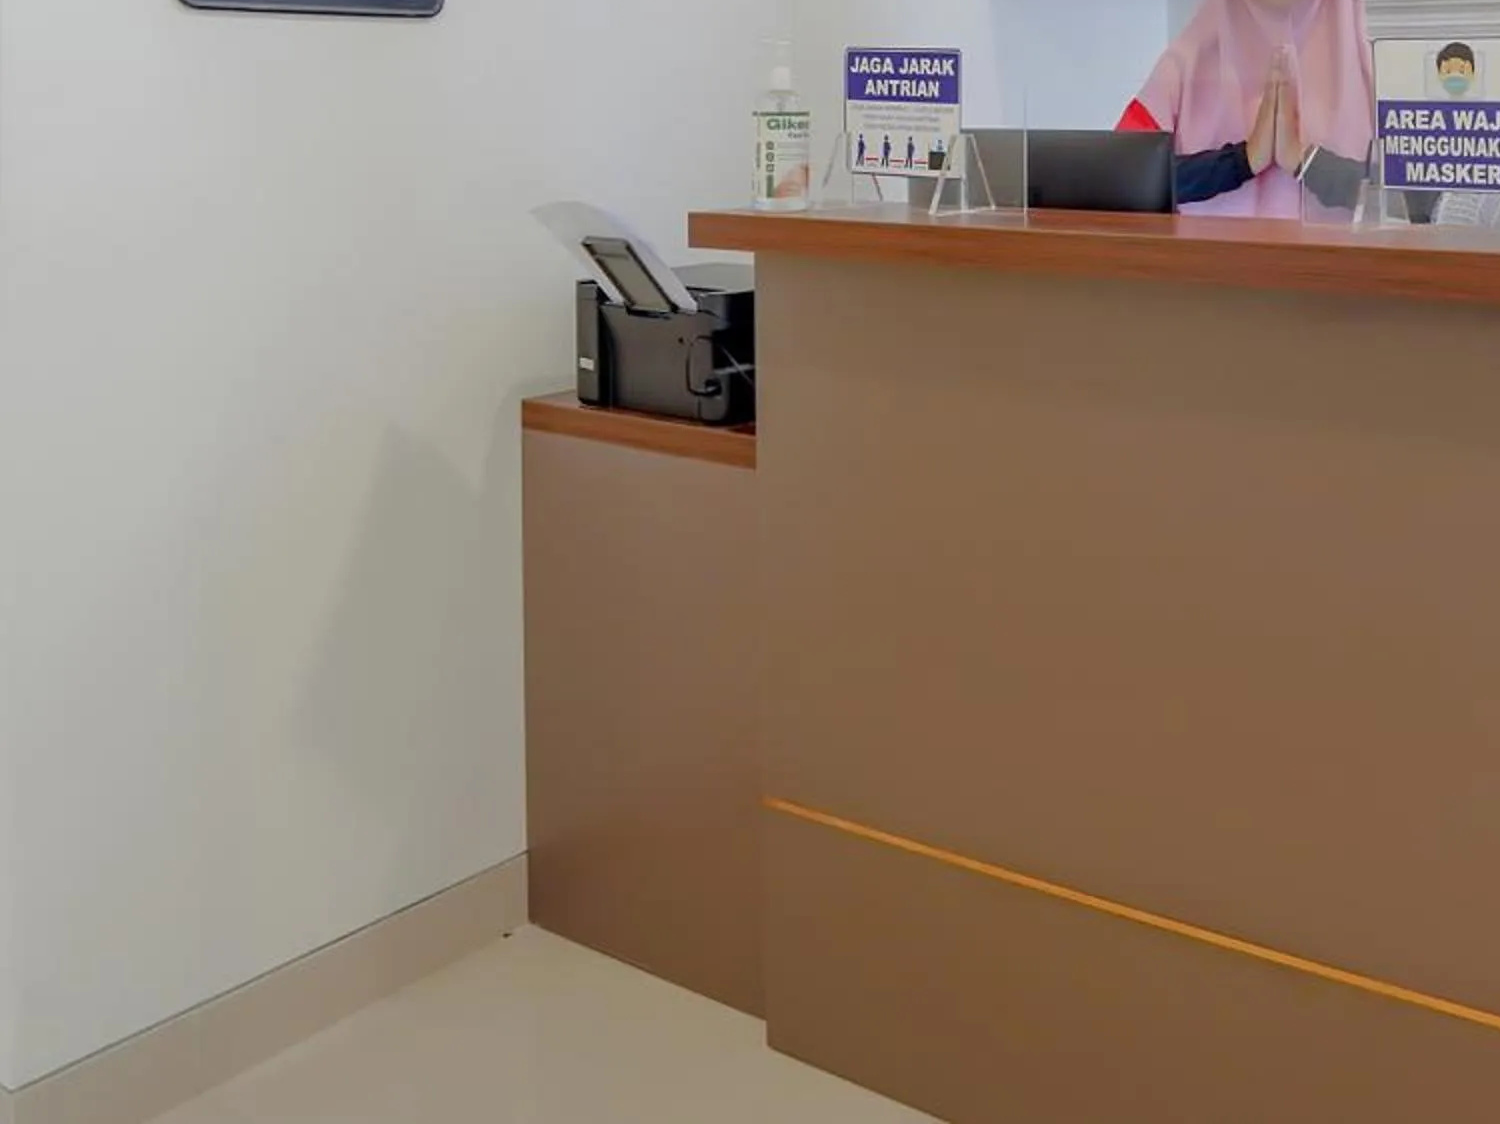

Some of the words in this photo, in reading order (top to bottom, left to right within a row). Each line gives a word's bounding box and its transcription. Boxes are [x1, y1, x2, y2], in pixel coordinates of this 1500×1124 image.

[850, 56, 894, 74] JAGA
[899, 58, 955, 76] JARAK
[864, 79, 939, 97] ANTRIAN
[1384, 109, 1446, 130] AREA
